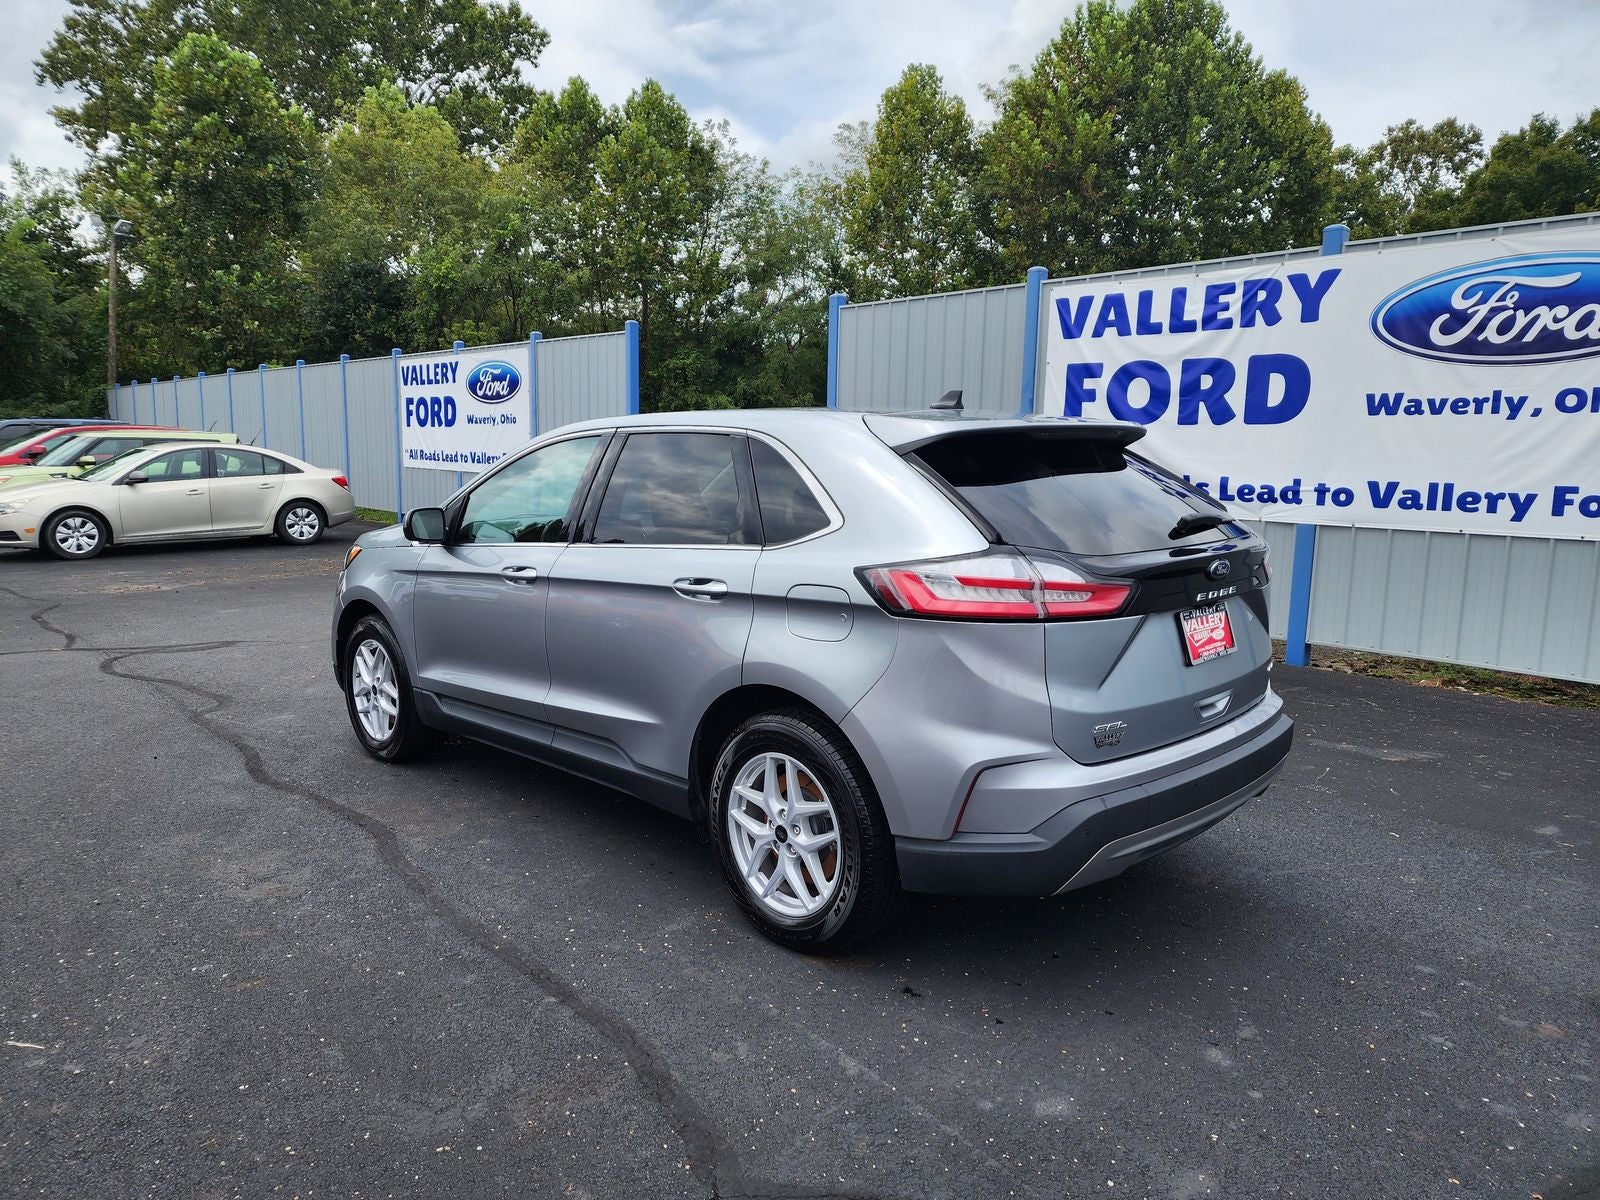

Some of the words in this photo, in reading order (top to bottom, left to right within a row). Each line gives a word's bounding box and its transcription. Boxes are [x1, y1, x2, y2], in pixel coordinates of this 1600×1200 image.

[1056, 268, 1342, 340] VALLERY
[401, 361, 459, 387] VALLERY
[476, 367, 511, 397] Ford
[1063, 353, 1312, 426] FORD
[405, 397, 456, 428] FORD
[1366, 389, 1543, 421] Waverly,
[466, 413, 499, 426] Waverly,
[500, 413, 517, 425] Ohio
[419, 449, 440, 462] Roads
[441, 450, 458, 463] Lead
[460, 452, 469, 464] to
[1219, 476, 1303, 505] Lead
[1314, 482, 1355, 508] to
[1367, 480, 1539, 523] Vallery
[1196, 585, 1238, 602] EDGE
[1183, 611, 1226, 633] VALLERY
[1093, 720, 1128, 733] SEL
